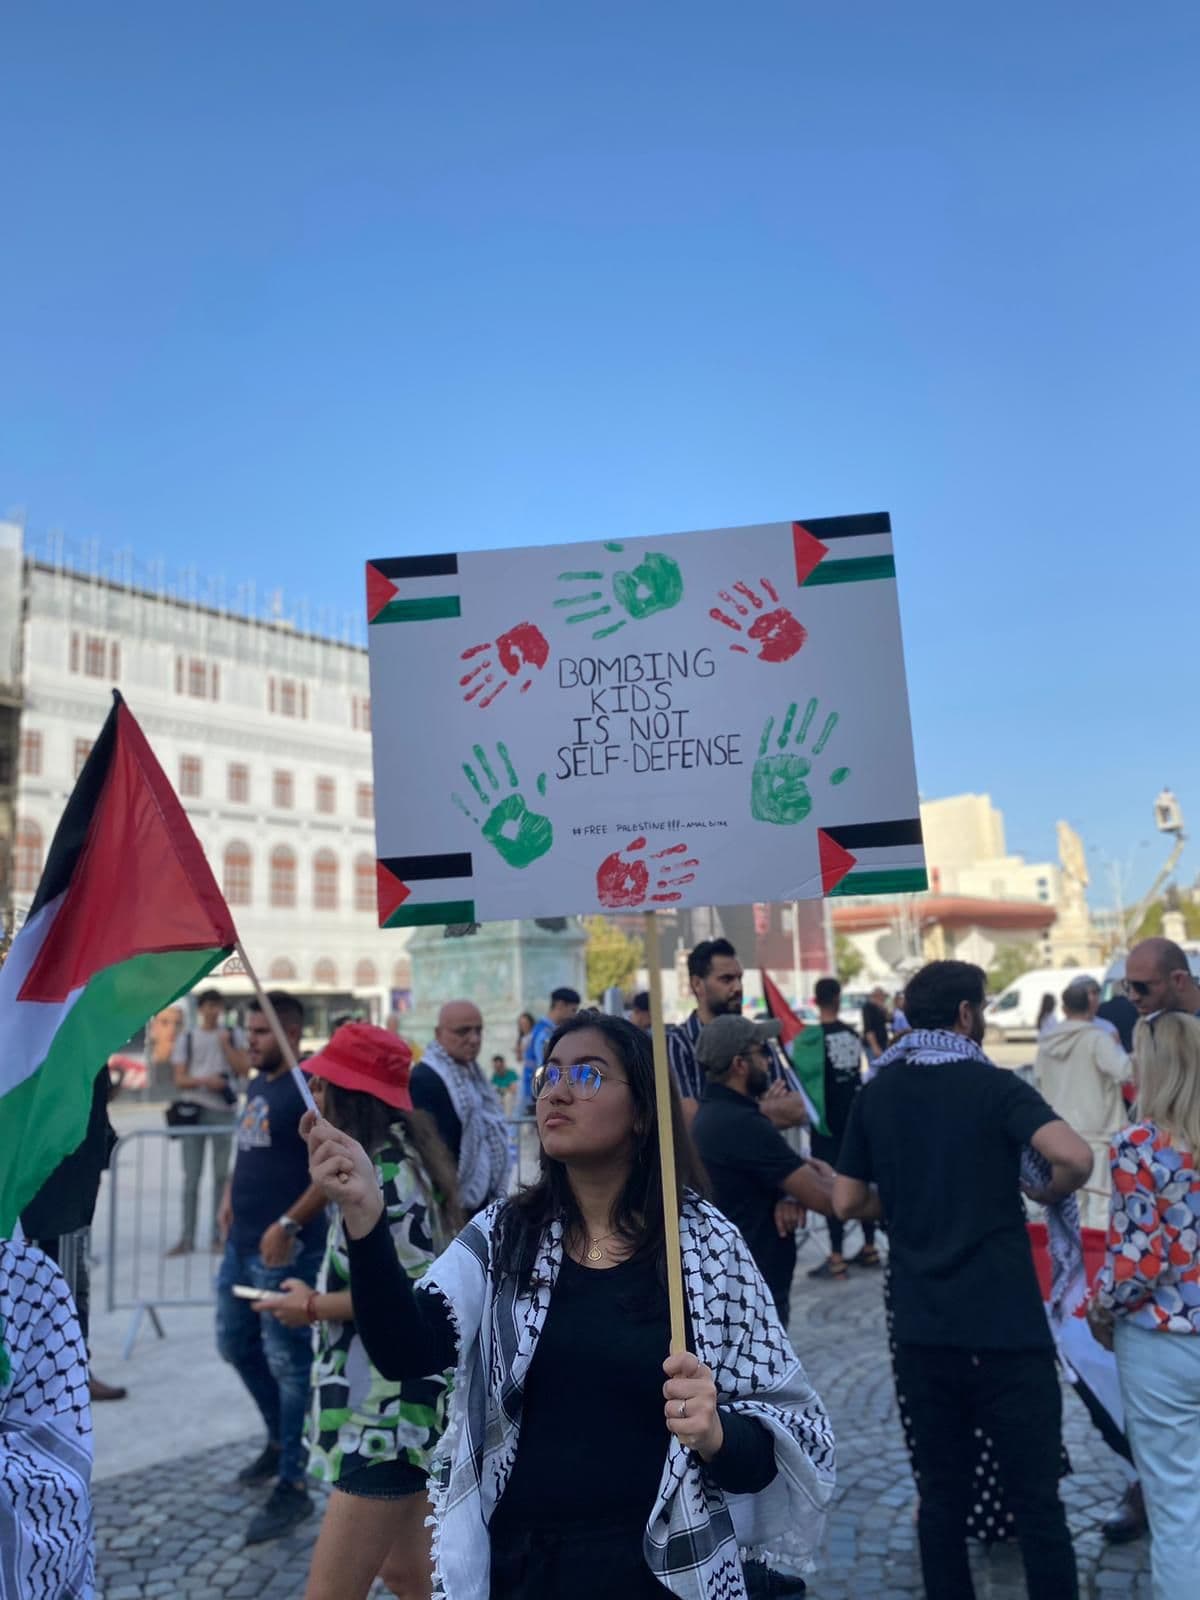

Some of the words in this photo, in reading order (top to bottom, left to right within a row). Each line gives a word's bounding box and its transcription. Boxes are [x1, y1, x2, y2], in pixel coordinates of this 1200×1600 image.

[558, 647, 716, 689] BOMBING
[591, 681, 673, 714] KIDS
[572, 715, 611, 746] IS
[630, 710, 690, 742] NOT
[555, 734, 744, 780] SELF-DEFENSE
